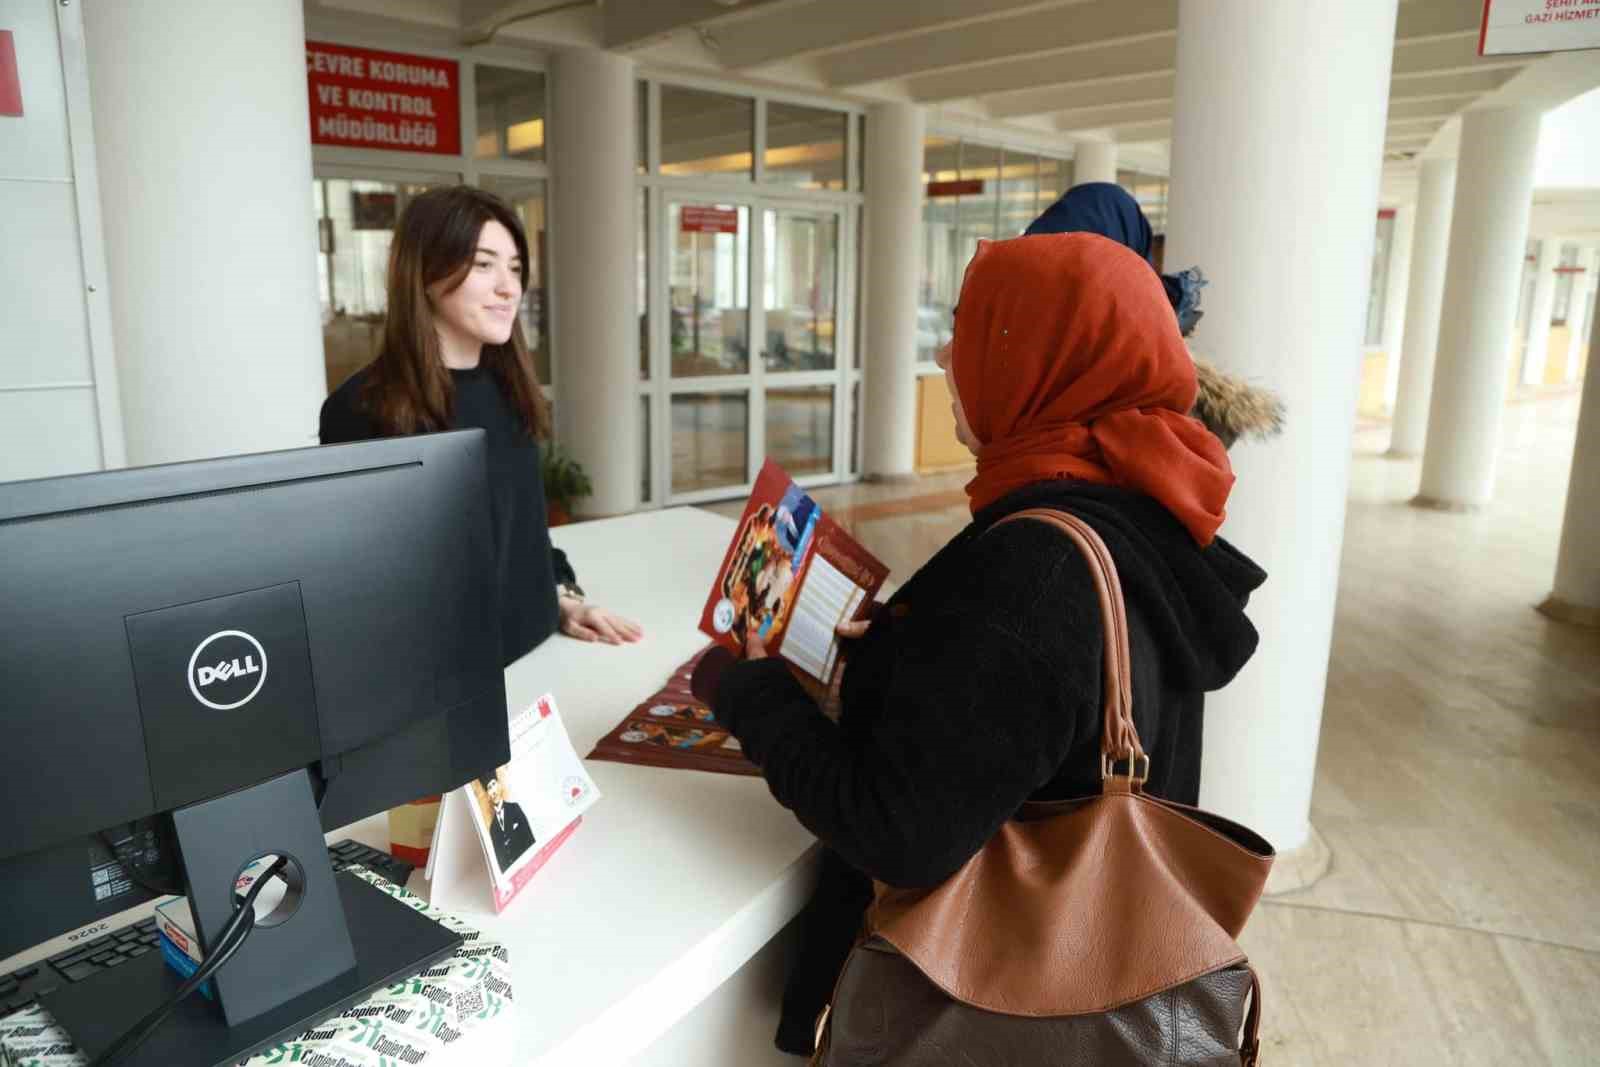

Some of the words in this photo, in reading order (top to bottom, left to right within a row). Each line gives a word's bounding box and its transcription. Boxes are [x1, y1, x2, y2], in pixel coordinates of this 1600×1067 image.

[369, 60, 449, 89] KORUMA
[317, 84, 343, 107] VE
[347, 87, 437, 118] KONTROL
[318, 113, 437, 149] MÜDÜRLÜĞÜ
[198, 655, 259, 686] DELL
[67, 922, 109, 942] 2026
[302, 1029, 337, 1041] Bond
[372, 1034, 404, 1057] Copier
[399, 1044, 426, 1064] Bond
